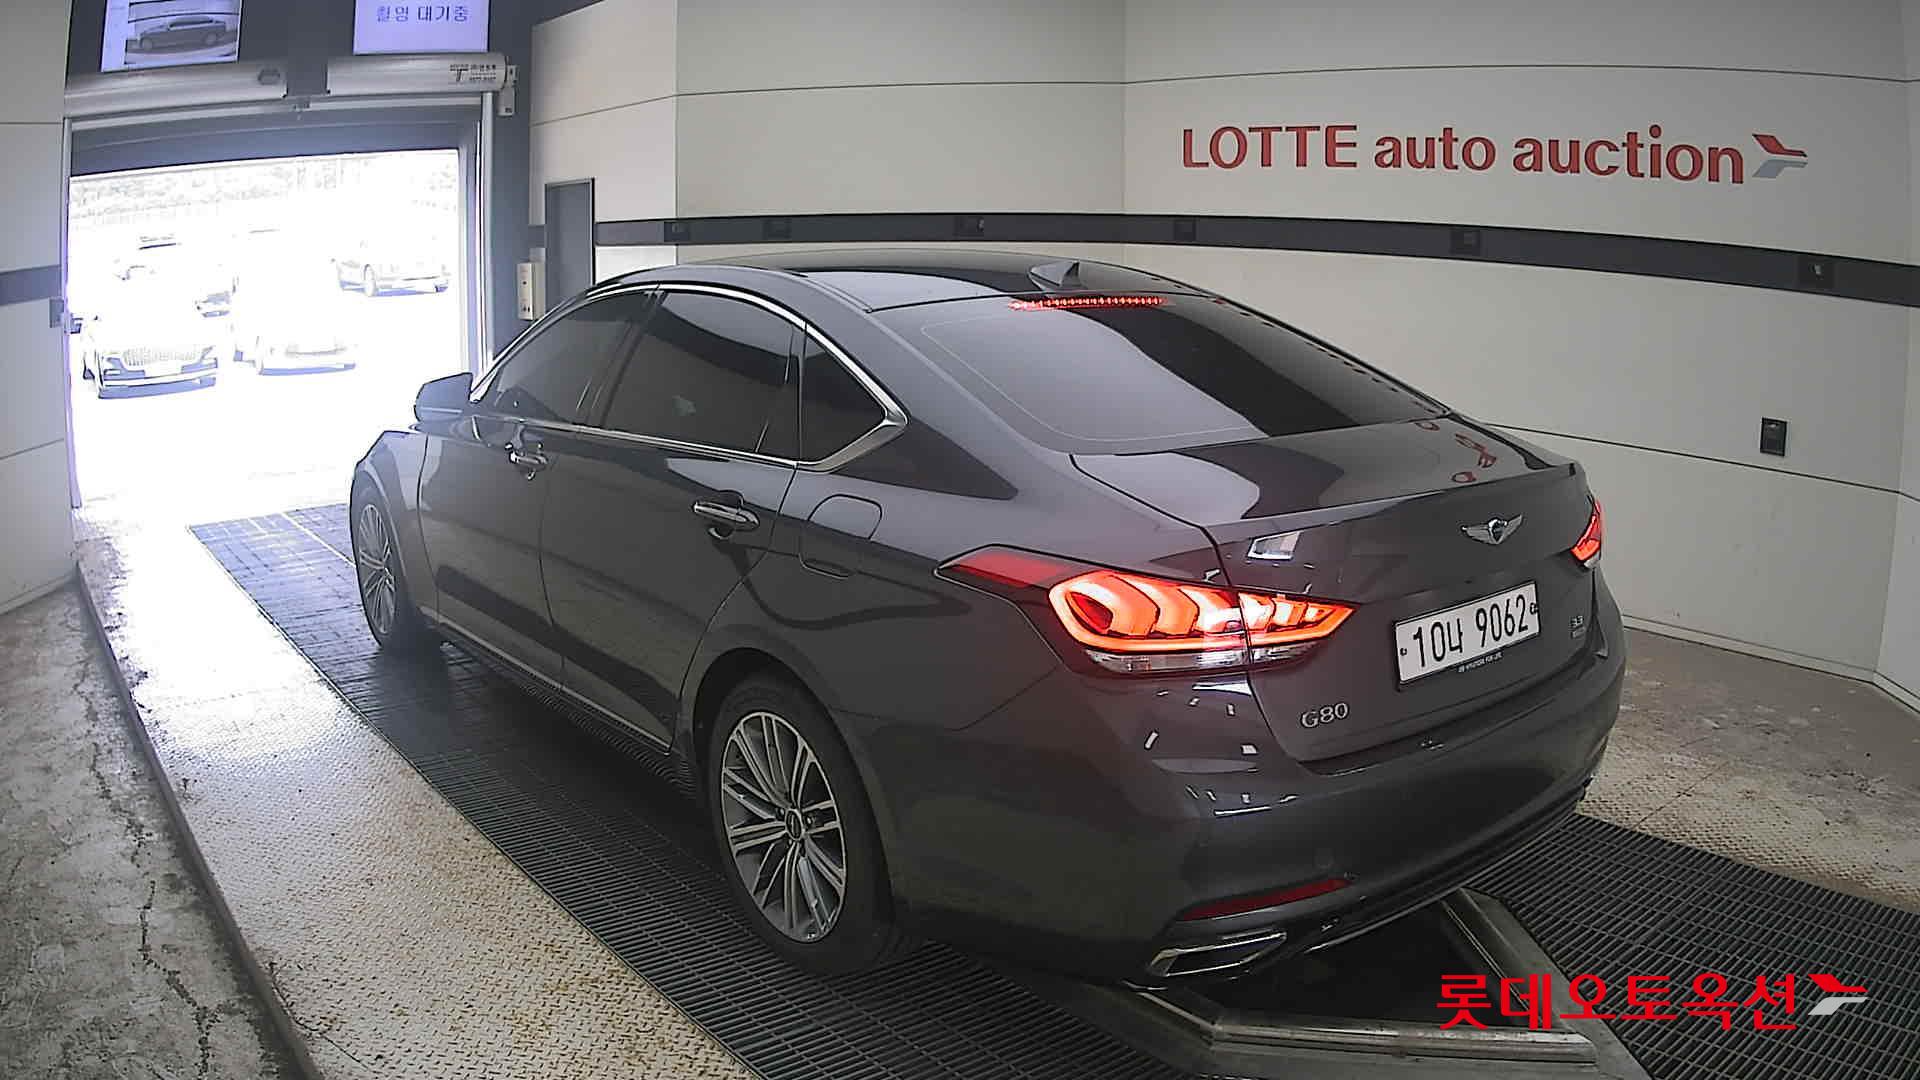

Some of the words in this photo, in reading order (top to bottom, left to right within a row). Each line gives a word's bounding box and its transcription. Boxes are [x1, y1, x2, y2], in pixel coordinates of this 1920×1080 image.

[417, 6, 468, 22] 대기중
[1183, 125, 1358, 169] LOTTE
[1374, 127, 1496, 171] auto
[1513, 125, 1744, 184] auction
[1413, 617, 1463, 668] 10나
[1475, 594, 1529, 648] 9062
[1301, 702, 1349, 728] G80
